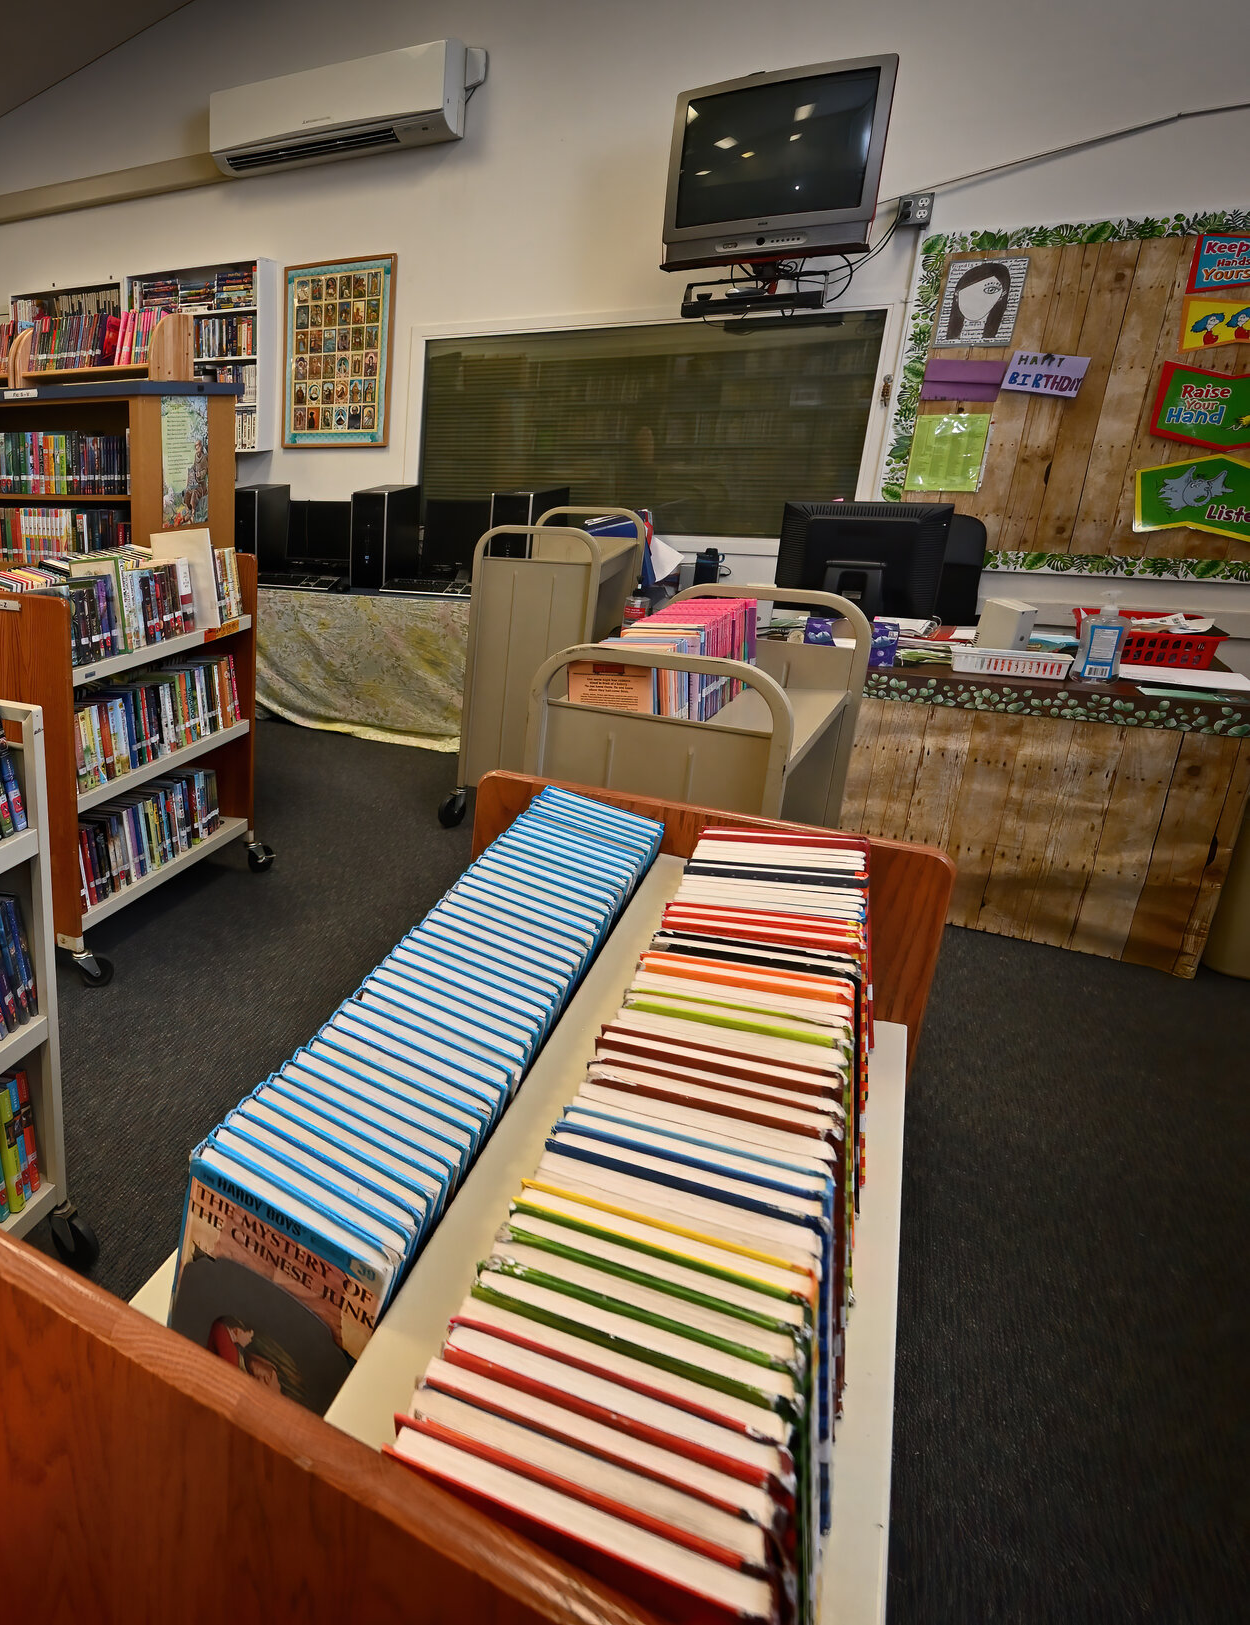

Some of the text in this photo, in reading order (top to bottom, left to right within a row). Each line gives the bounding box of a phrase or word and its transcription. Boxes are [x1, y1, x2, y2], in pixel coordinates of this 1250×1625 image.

[1204, 240, 1250, 259] Keep
[1216, 257, 1250, 268] Hands
[1202, 267, 1250, 282] Yours
[1017, 354, 1065, 368] HAPPY
[1008, 371, 1083, 393] BIRTHDAY
[1181, 384, 1232, 400] Raise
[1185, 399, 1219, 411] Your
[1165, 405, 1226, 425] Hand
[1205, 504, 1250, 524] Liste
[217, 1176, 302, 1238] HARDY BOYS
[197, 1185, 373, 1304] THE MYSTERY OF
[190, 1200, 375, 1330] THE CHINESE JUNK
[357, 1265, 376, 1283] 39
